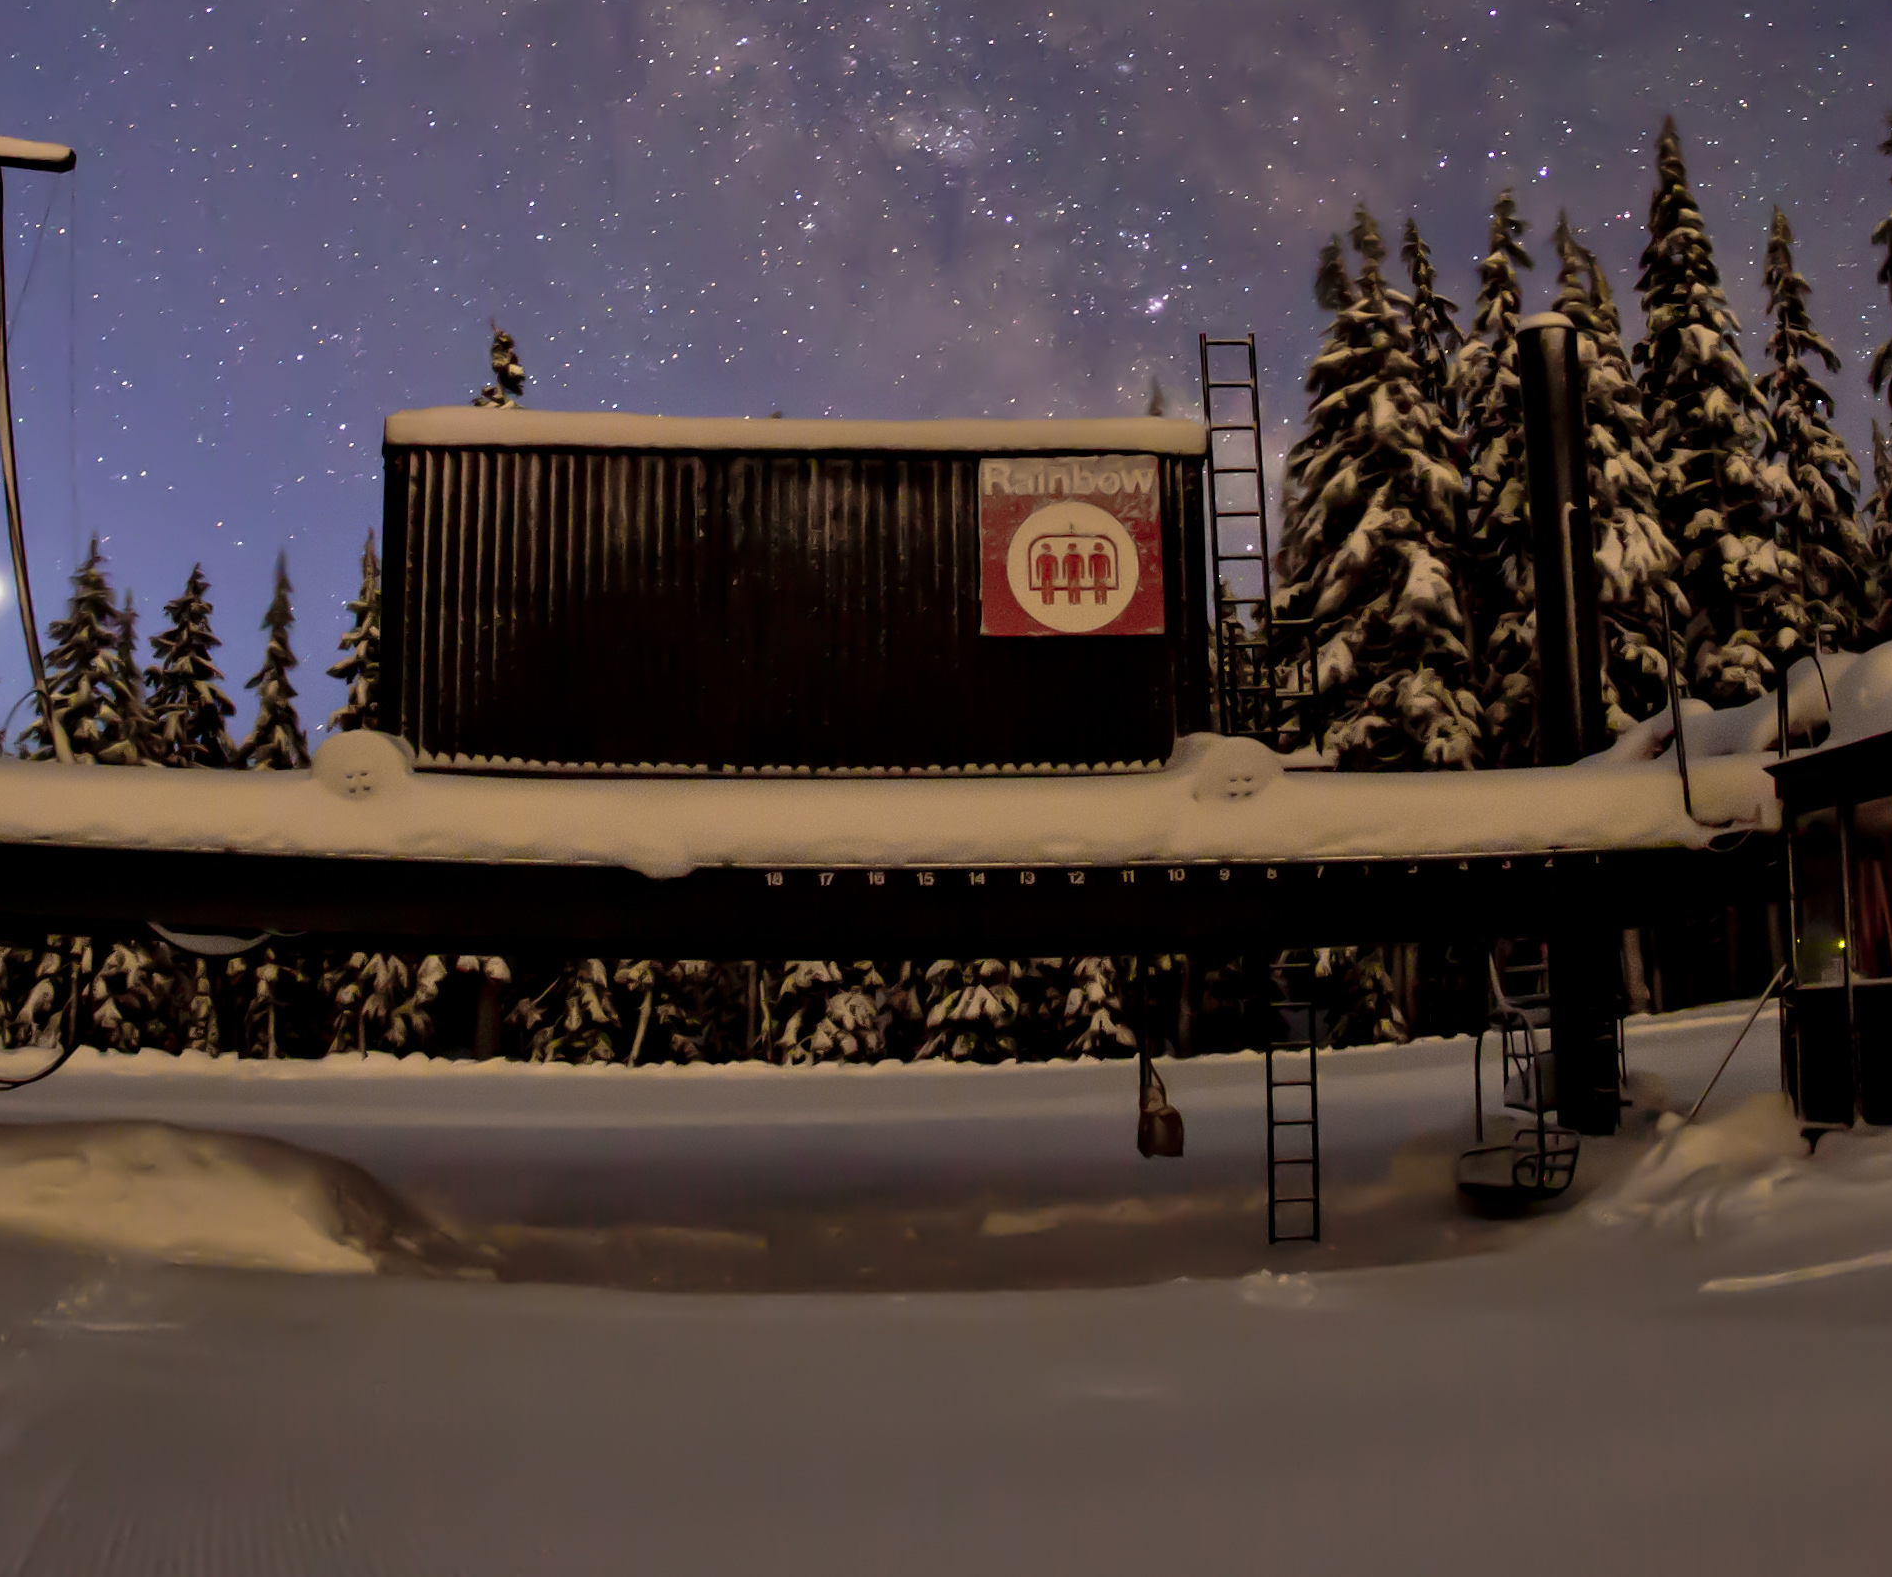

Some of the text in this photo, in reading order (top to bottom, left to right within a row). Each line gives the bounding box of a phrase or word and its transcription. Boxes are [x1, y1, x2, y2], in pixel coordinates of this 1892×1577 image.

[983, 464, 1156, 495] Rainbow
[818, 872, 835, 886] 17
[917, 872, 935, 886] 15
[969, 872, 986, 886] 14
[1067, 871, 1086, 885] 12
[1120, 870, 1135, 883] 11
[1168, 868, 1186, 882] 10
